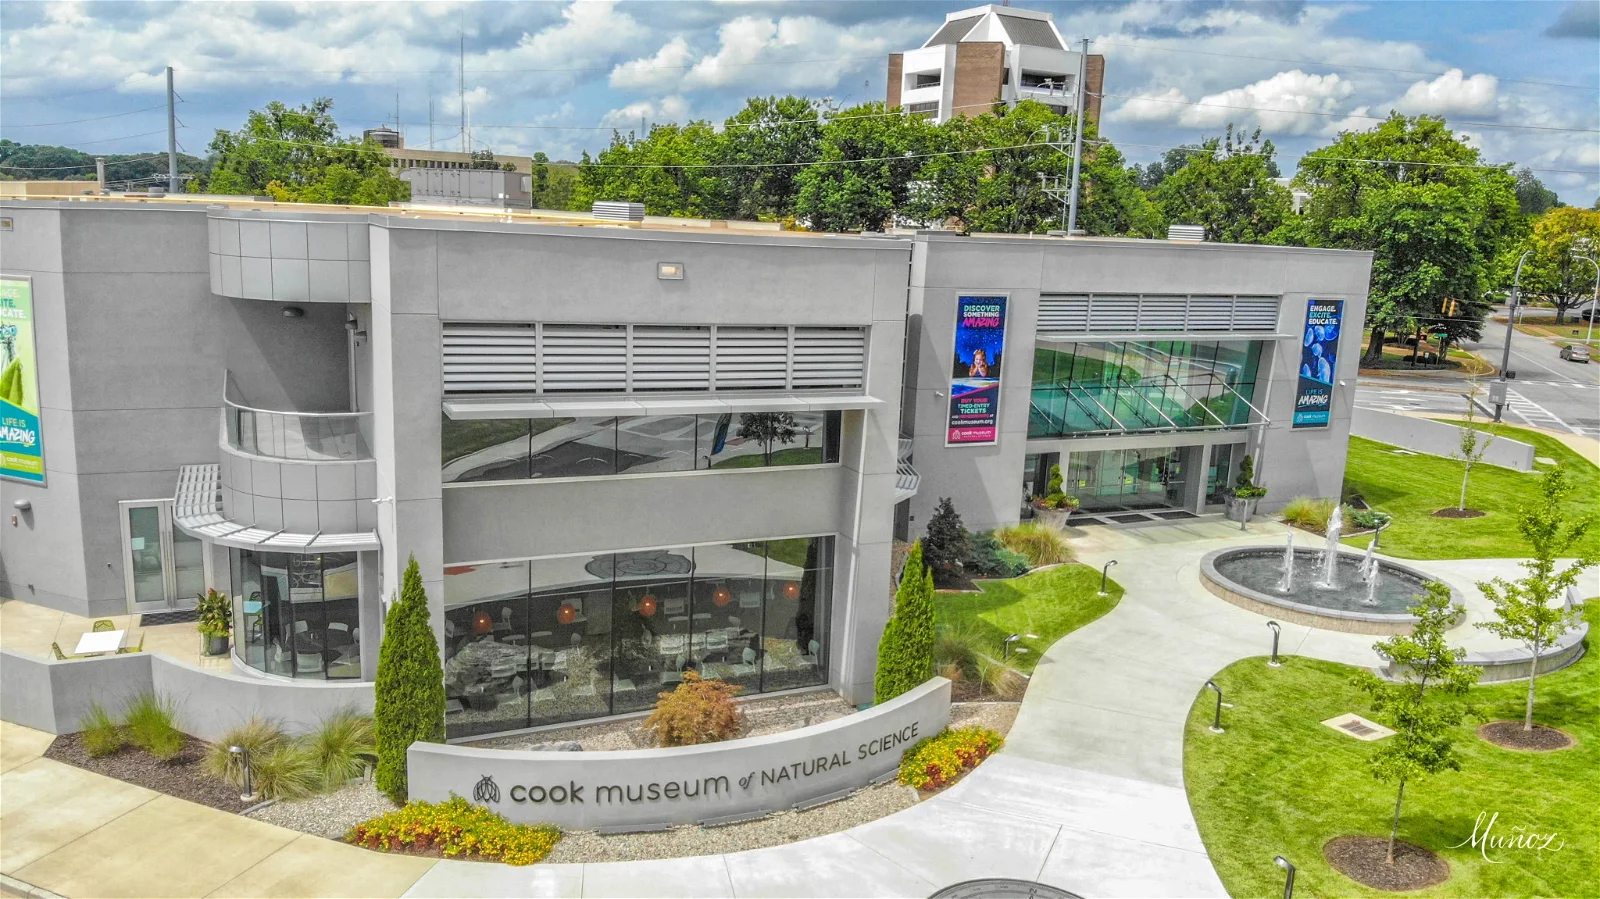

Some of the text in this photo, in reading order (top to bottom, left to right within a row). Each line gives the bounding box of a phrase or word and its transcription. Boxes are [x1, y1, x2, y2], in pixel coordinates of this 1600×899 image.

[0, 308, 26, 318] CATE.
[962, 317, 1000, 327] AMAZING
[1298, 394, 1328, 405] AMAZING
[2, 416, 26, 428] LIFE IS
[0, 425, 36, 444] MAZING
[509, 721, 919, 803] cook museum of NATURAL SCIENCE
